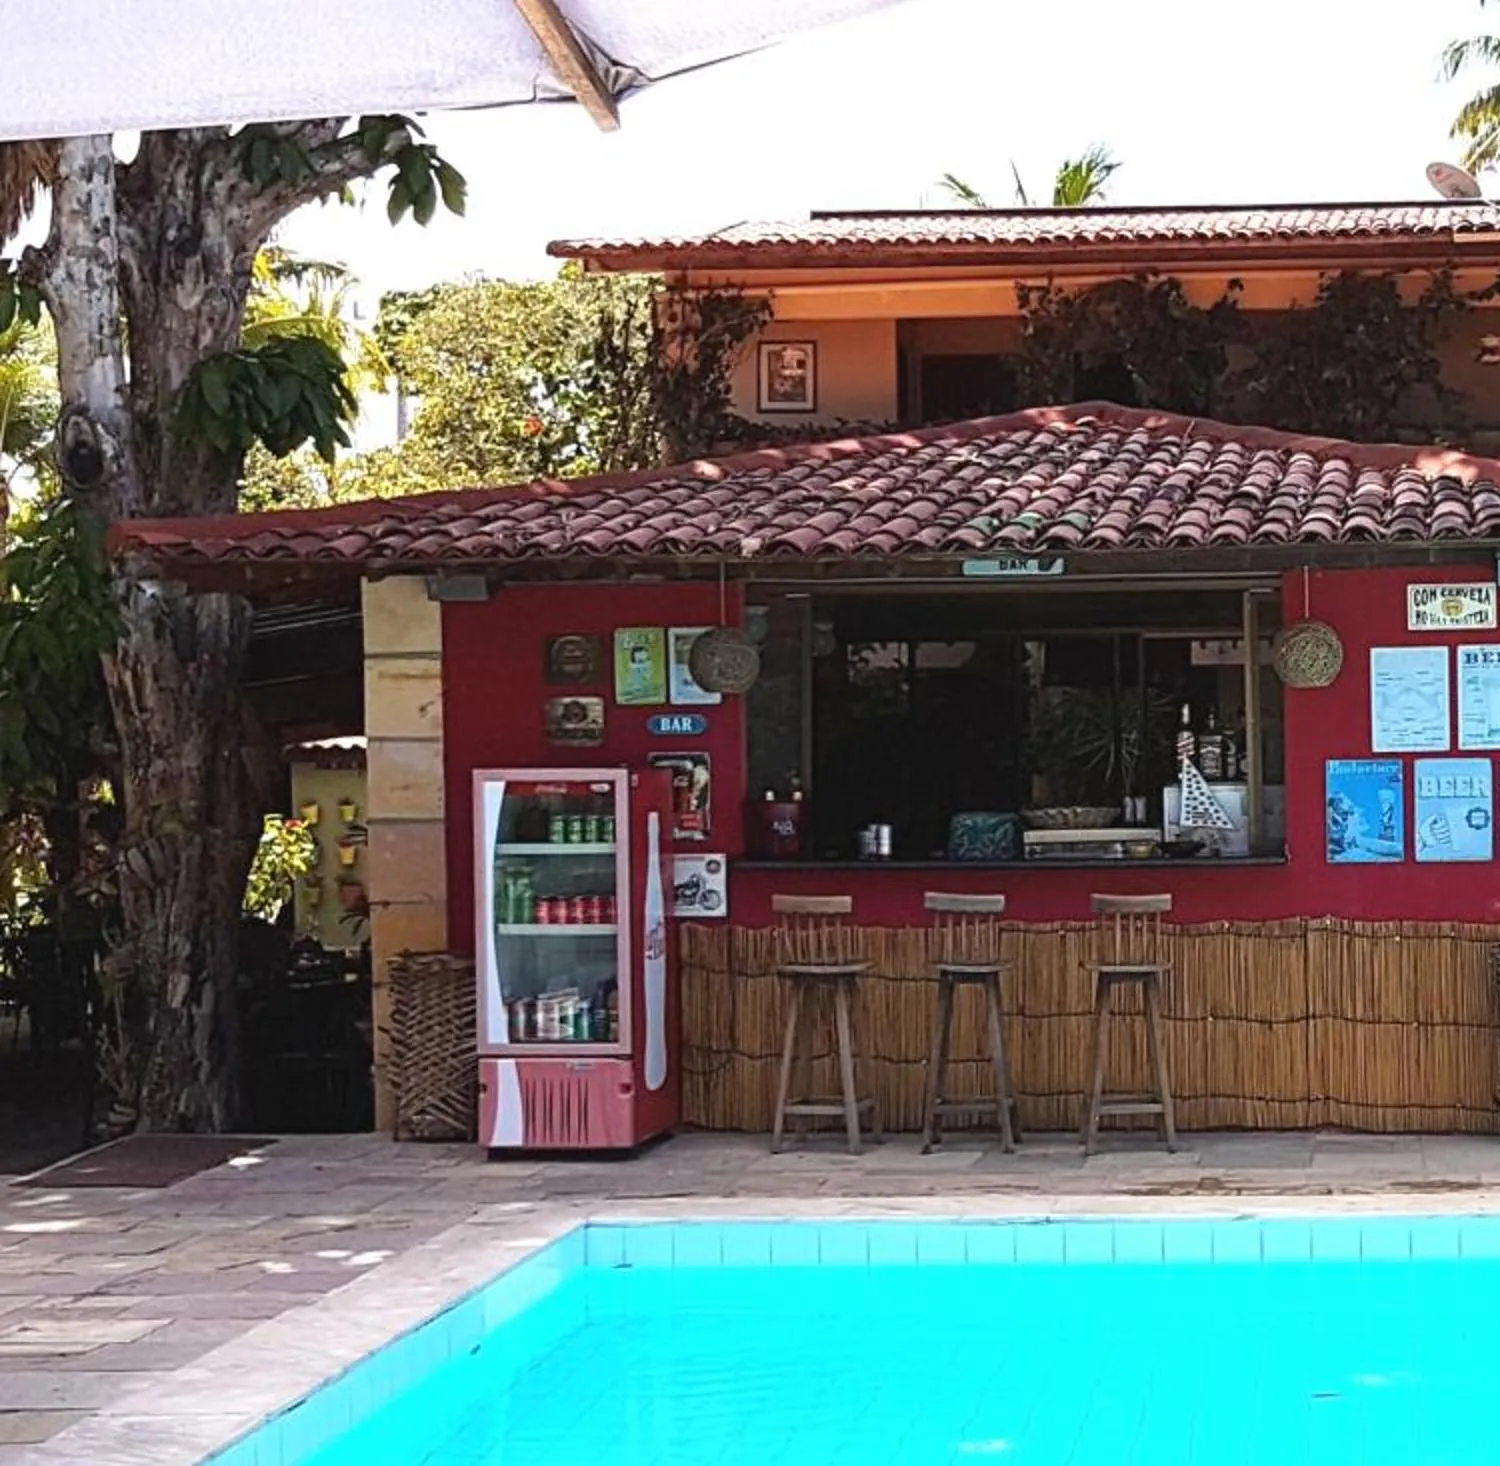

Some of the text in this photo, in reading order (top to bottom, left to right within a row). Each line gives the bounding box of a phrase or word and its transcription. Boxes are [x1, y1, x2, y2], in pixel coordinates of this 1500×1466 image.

[998, 558, 1028, 571] BAR
[660, 717, 692, 731] BAR
[1418, 775, 1489, 798] BEER
